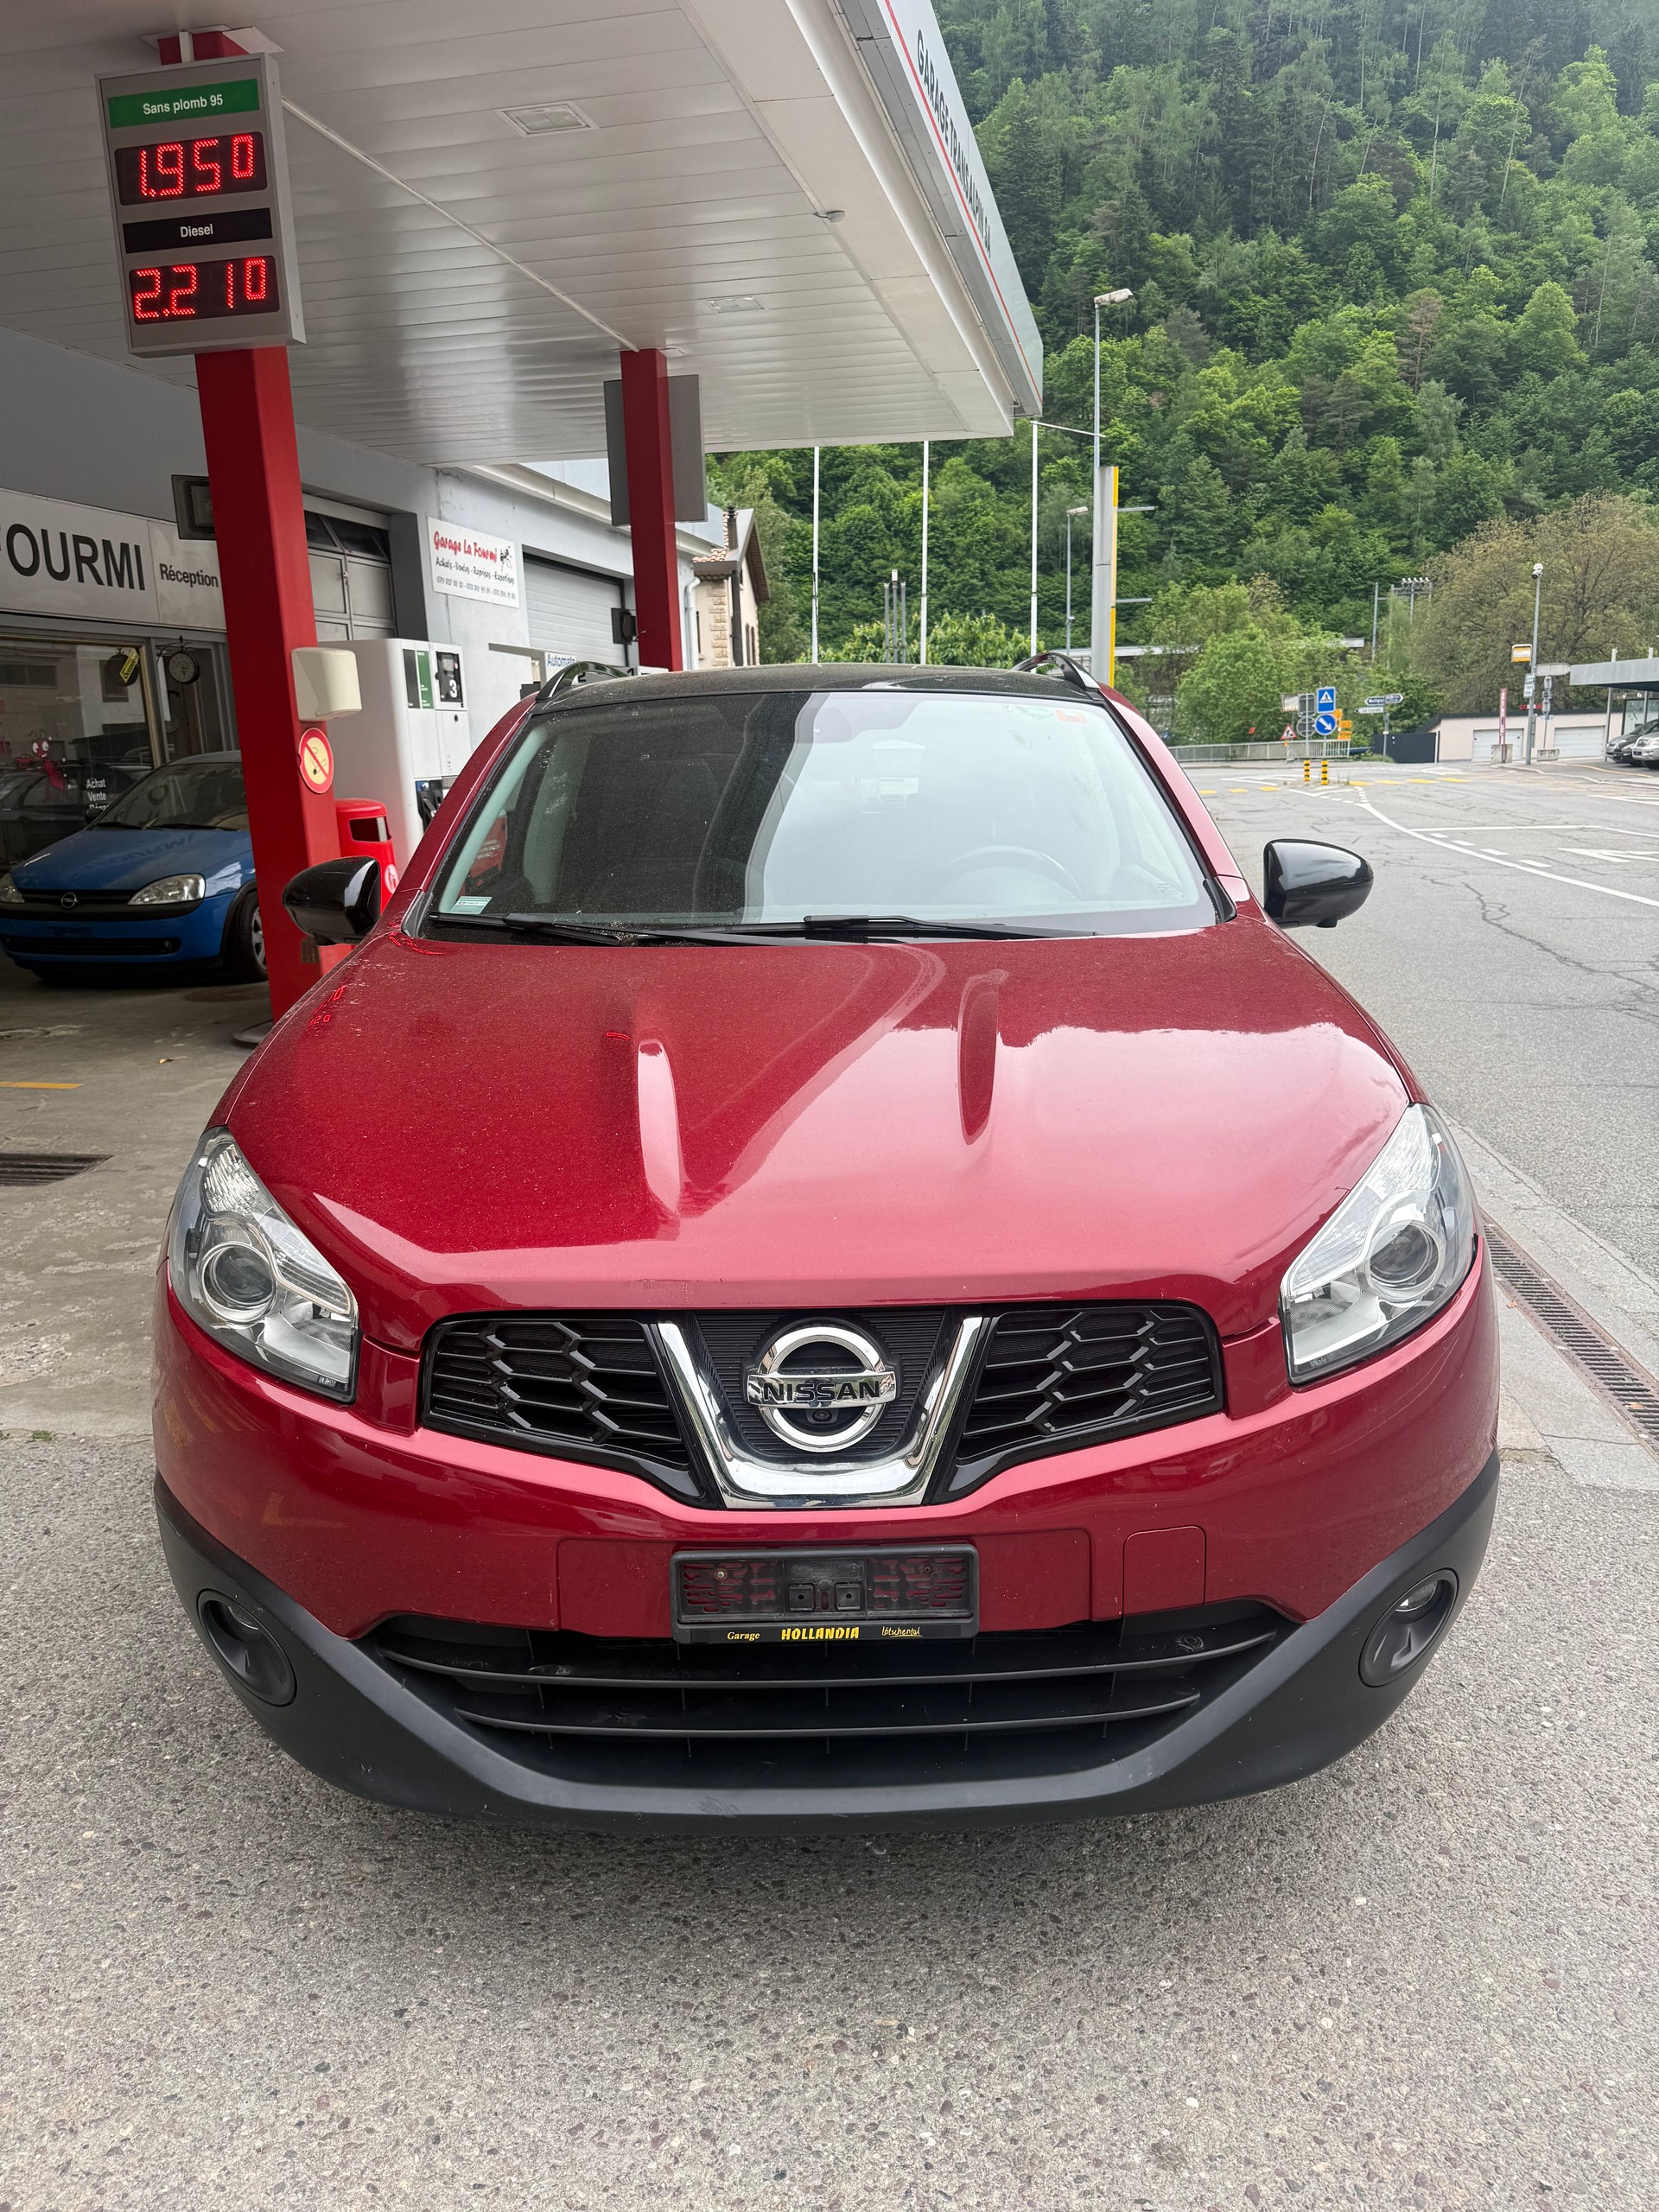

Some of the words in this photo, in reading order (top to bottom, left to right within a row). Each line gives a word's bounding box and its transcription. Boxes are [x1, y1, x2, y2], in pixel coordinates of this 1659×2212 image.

[143, 102, 170, 115] Sans
[173, 96, 207, 114] plomb
[210, 94, 223, 106] 95
[917, 29, 949, 145] GARAGE
[950, 117, 984, 238] TRANSALPIN
[139, 135, 254, 198] 1.950
[180, 223, 213, 238] Diesel
[0, 523, 146, 591] OURMI
[434, 531, 461, 556] Garage
[463, 539, 472, 555] La
[474, 542, 497, 563] Fourmi
[159, 563, 219, 588] Réception
[448, 679, 458, 698] 3
[86, 778, 106, 790] Achat
[87, 791, 107, 802] Vente
[763, 1381, 880, 1403] NISSAN
[727, 1631, 760, 1642] Garage
[781, 1626, 860, 1641] HOLLANDIA
